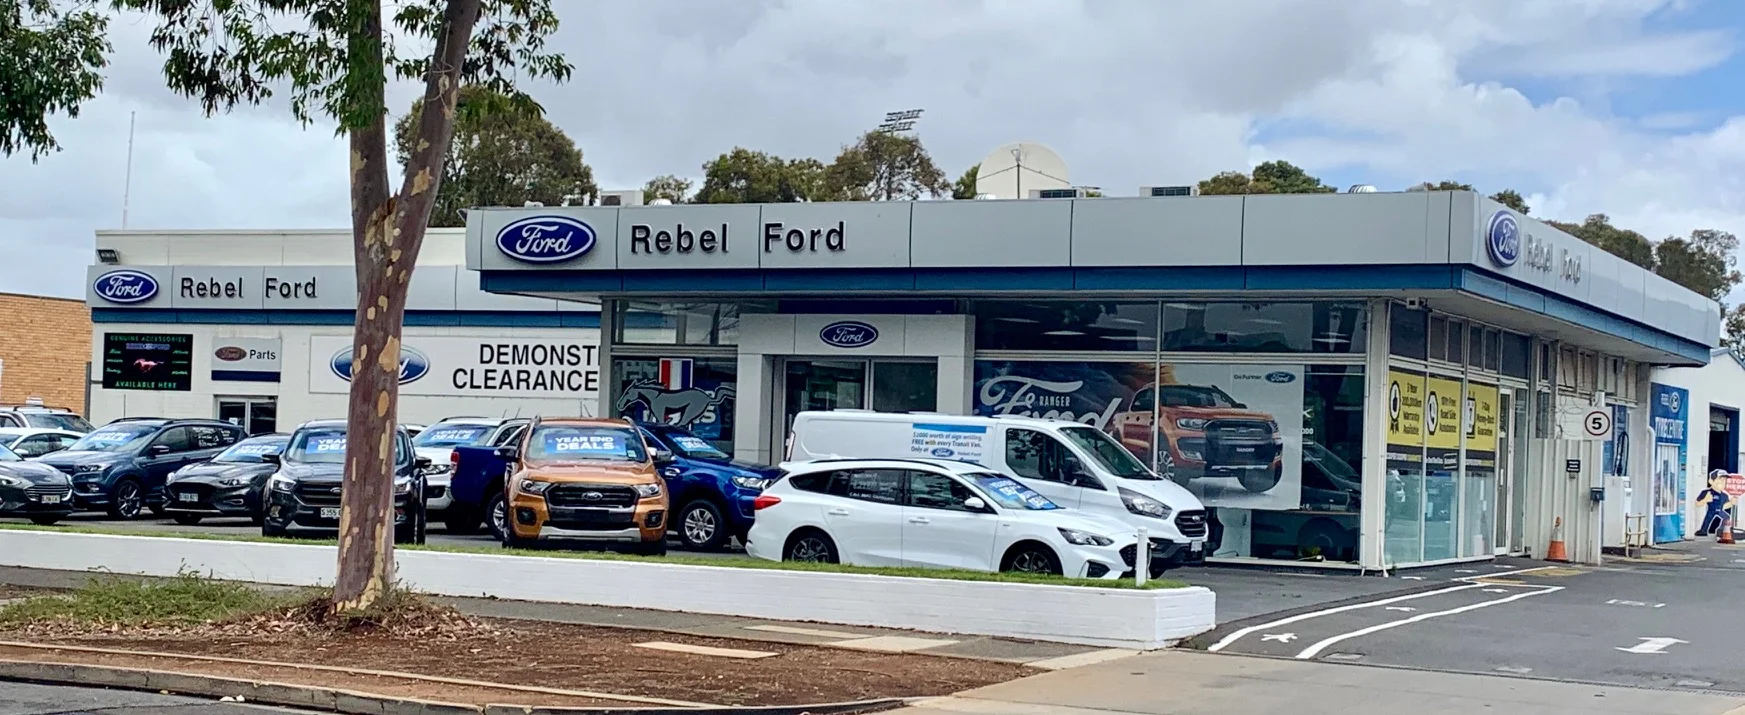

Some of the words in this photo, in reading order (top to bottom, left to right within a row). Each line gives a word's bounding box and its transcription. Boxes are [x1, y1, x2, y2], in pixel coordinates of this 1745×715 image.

[516, 224, 572, 254] Ford
[631, 222, 730, 254] Rebel
[764, 220, 846, 252] Ford
[1498, 220, 1518, 256] Ford
[1524, 234, 1553, 272] Rebel
[1560, 248, 1581, 284] Ford
[105, 276, 142, 296] Ford
[181, 277, 244, 298] Rebel
[266, 277, 318, 298] Ford
[832, 326, 864, 342] Ford
[250, 349, 276, 360] Parts
[453, 368, 598, 391] CLEARANCE
[1270, 373, 1290, 382] Ford
[1039, 396, 1070, 407] RANGER
[1592, 418, 1603, 430] 5
[556, 442, 614, 450] DEALS
